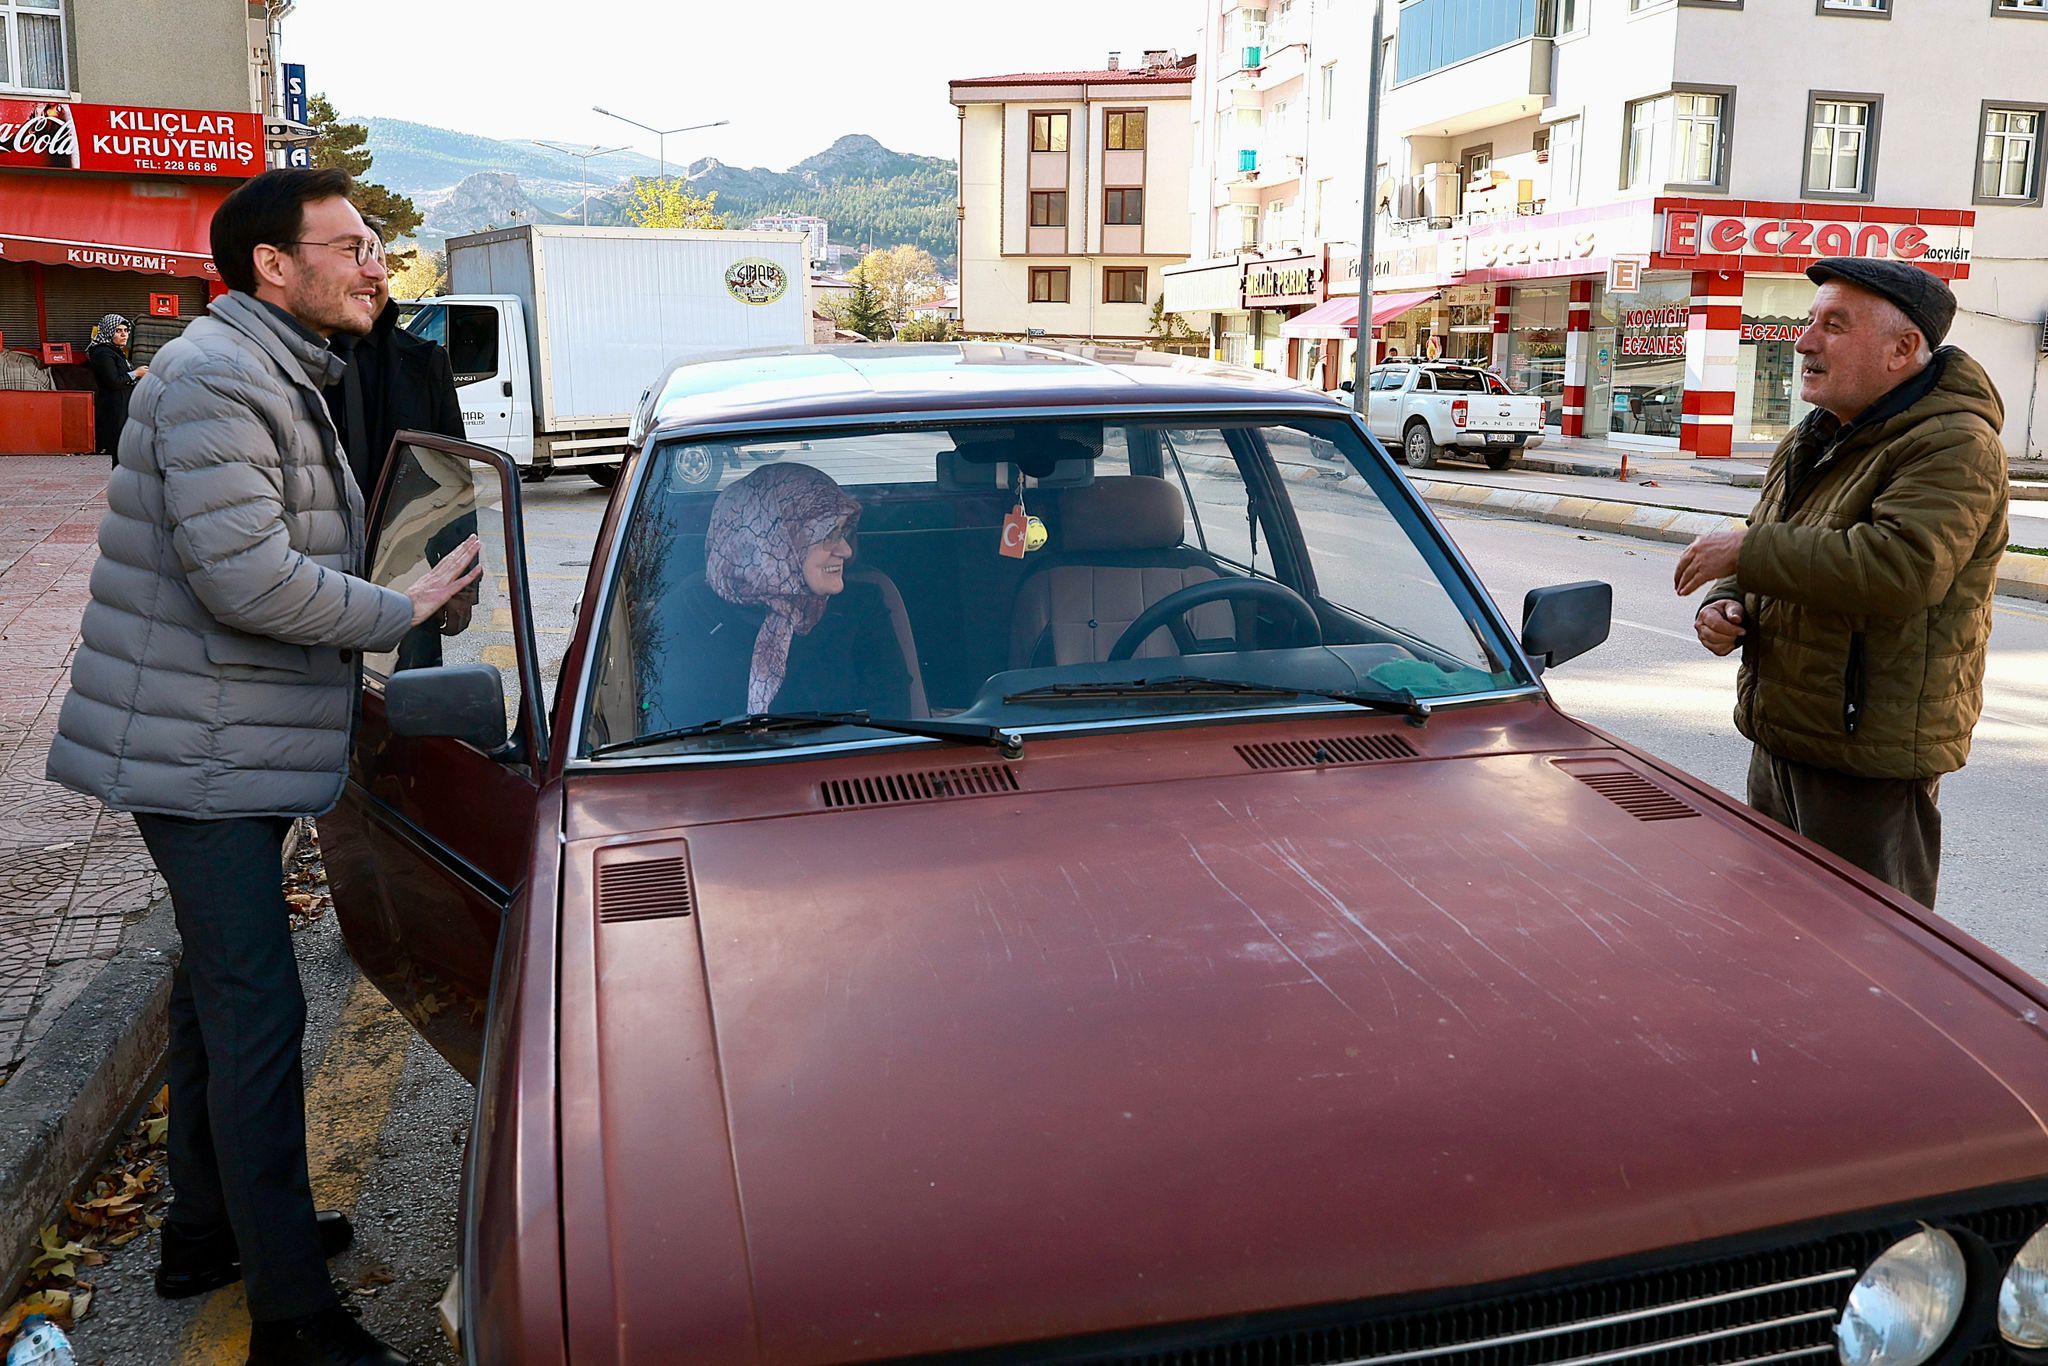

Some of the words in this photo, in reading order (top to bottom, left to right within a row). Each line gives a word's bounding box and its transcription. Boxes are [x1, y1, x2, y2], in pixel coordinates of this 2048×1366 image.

[109, 110, 235, 137] KILIÇLAR
[93, 134, 254, 165] KURUYEMİŞ
[134, 159, 161, 169] TEL:
[164, 160, 184, 170] 228
[188, 161, 201, 171] 66
[204, 161, 217, 172] 86
[1707, 218, 1930, 258] eczane
[1923, 246, 1970, 261] KOÇYİĞİT
[1279, 269, 1313, 294] PERDE
[1626, 304, 1689, 332] KOÇYİĞİT
[1740, 324, 1808, 341] ECZAN
